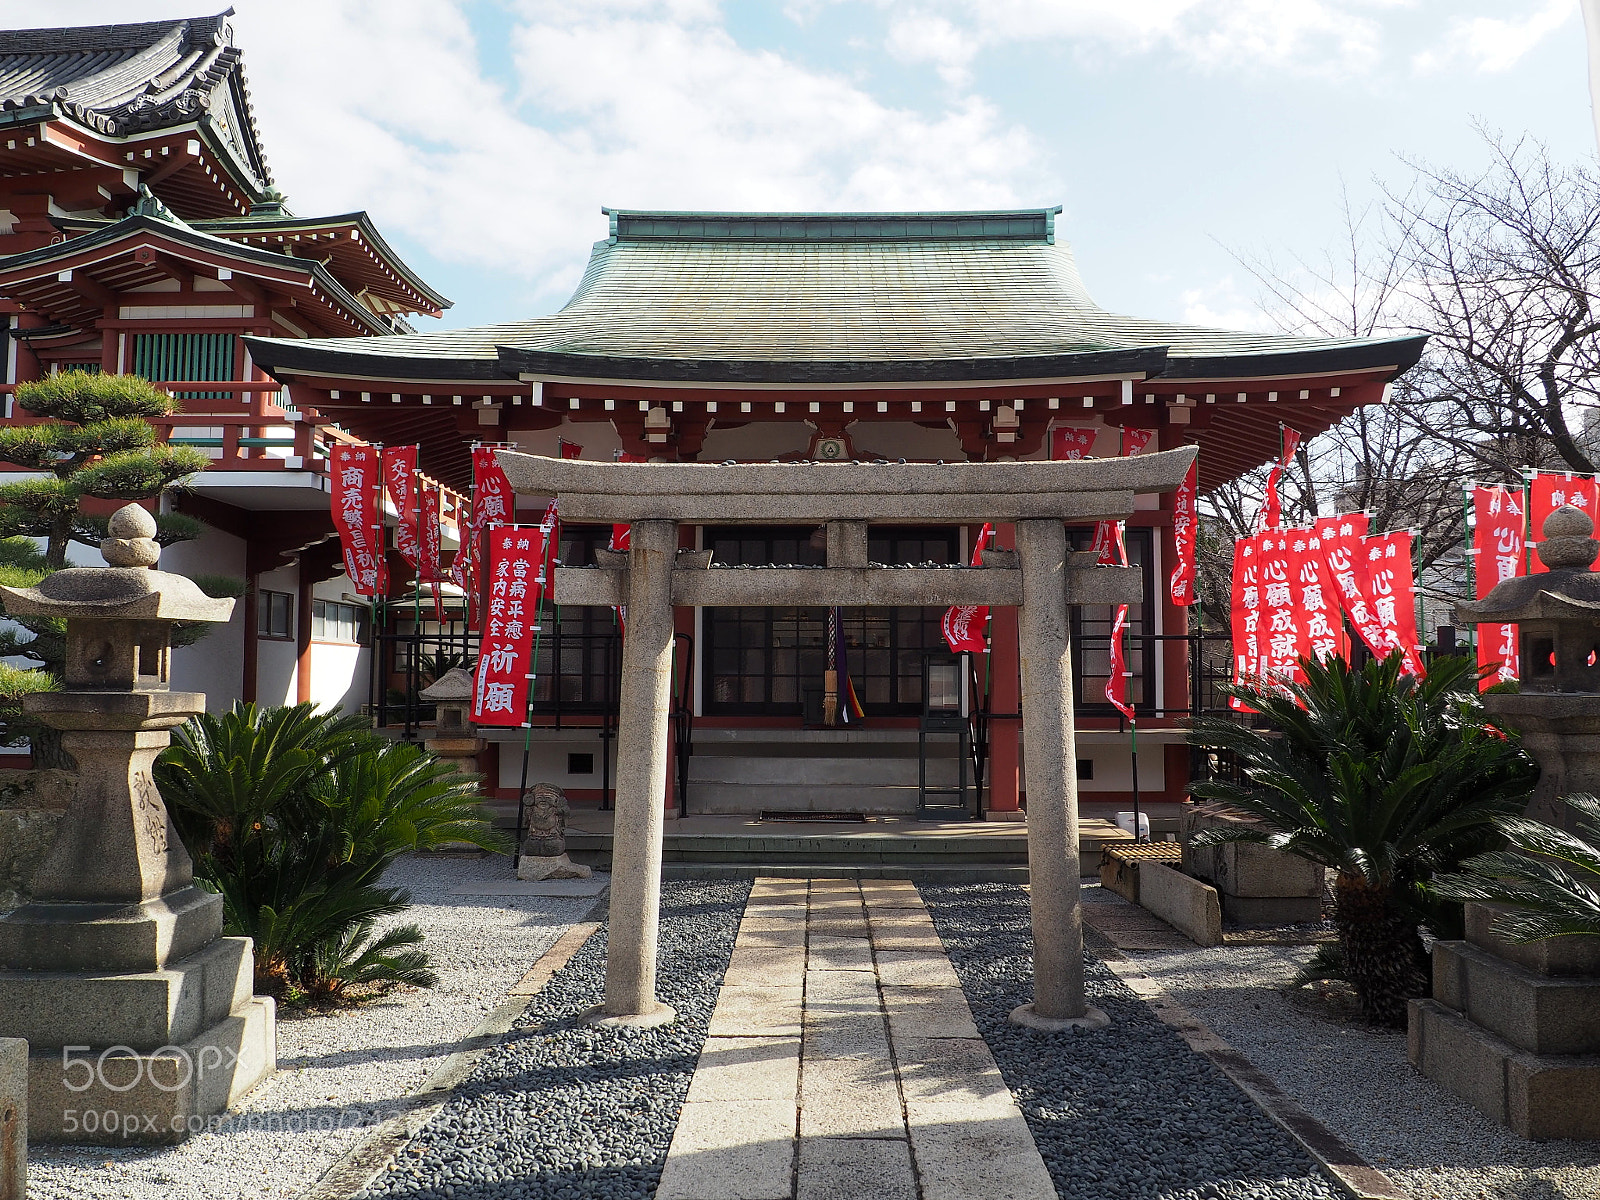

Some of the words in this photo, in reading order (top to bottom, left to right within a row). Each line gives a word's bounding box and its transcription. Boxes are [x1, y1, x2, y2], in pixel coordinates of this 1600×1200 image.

[340, 451, 366, 462] 奉納
[1322, 523, 1353, 540] 奉納
[502, 537, 530, 551] 奉納
[1292, 537, 1320, 553] 奉納
[1368, 543, 1396, 561] 奉納
[488, 558, 510, 638] 家内安全
[505, 558, 530, 640] 當病平癒
[484, 642, 519, 714] 祈願
